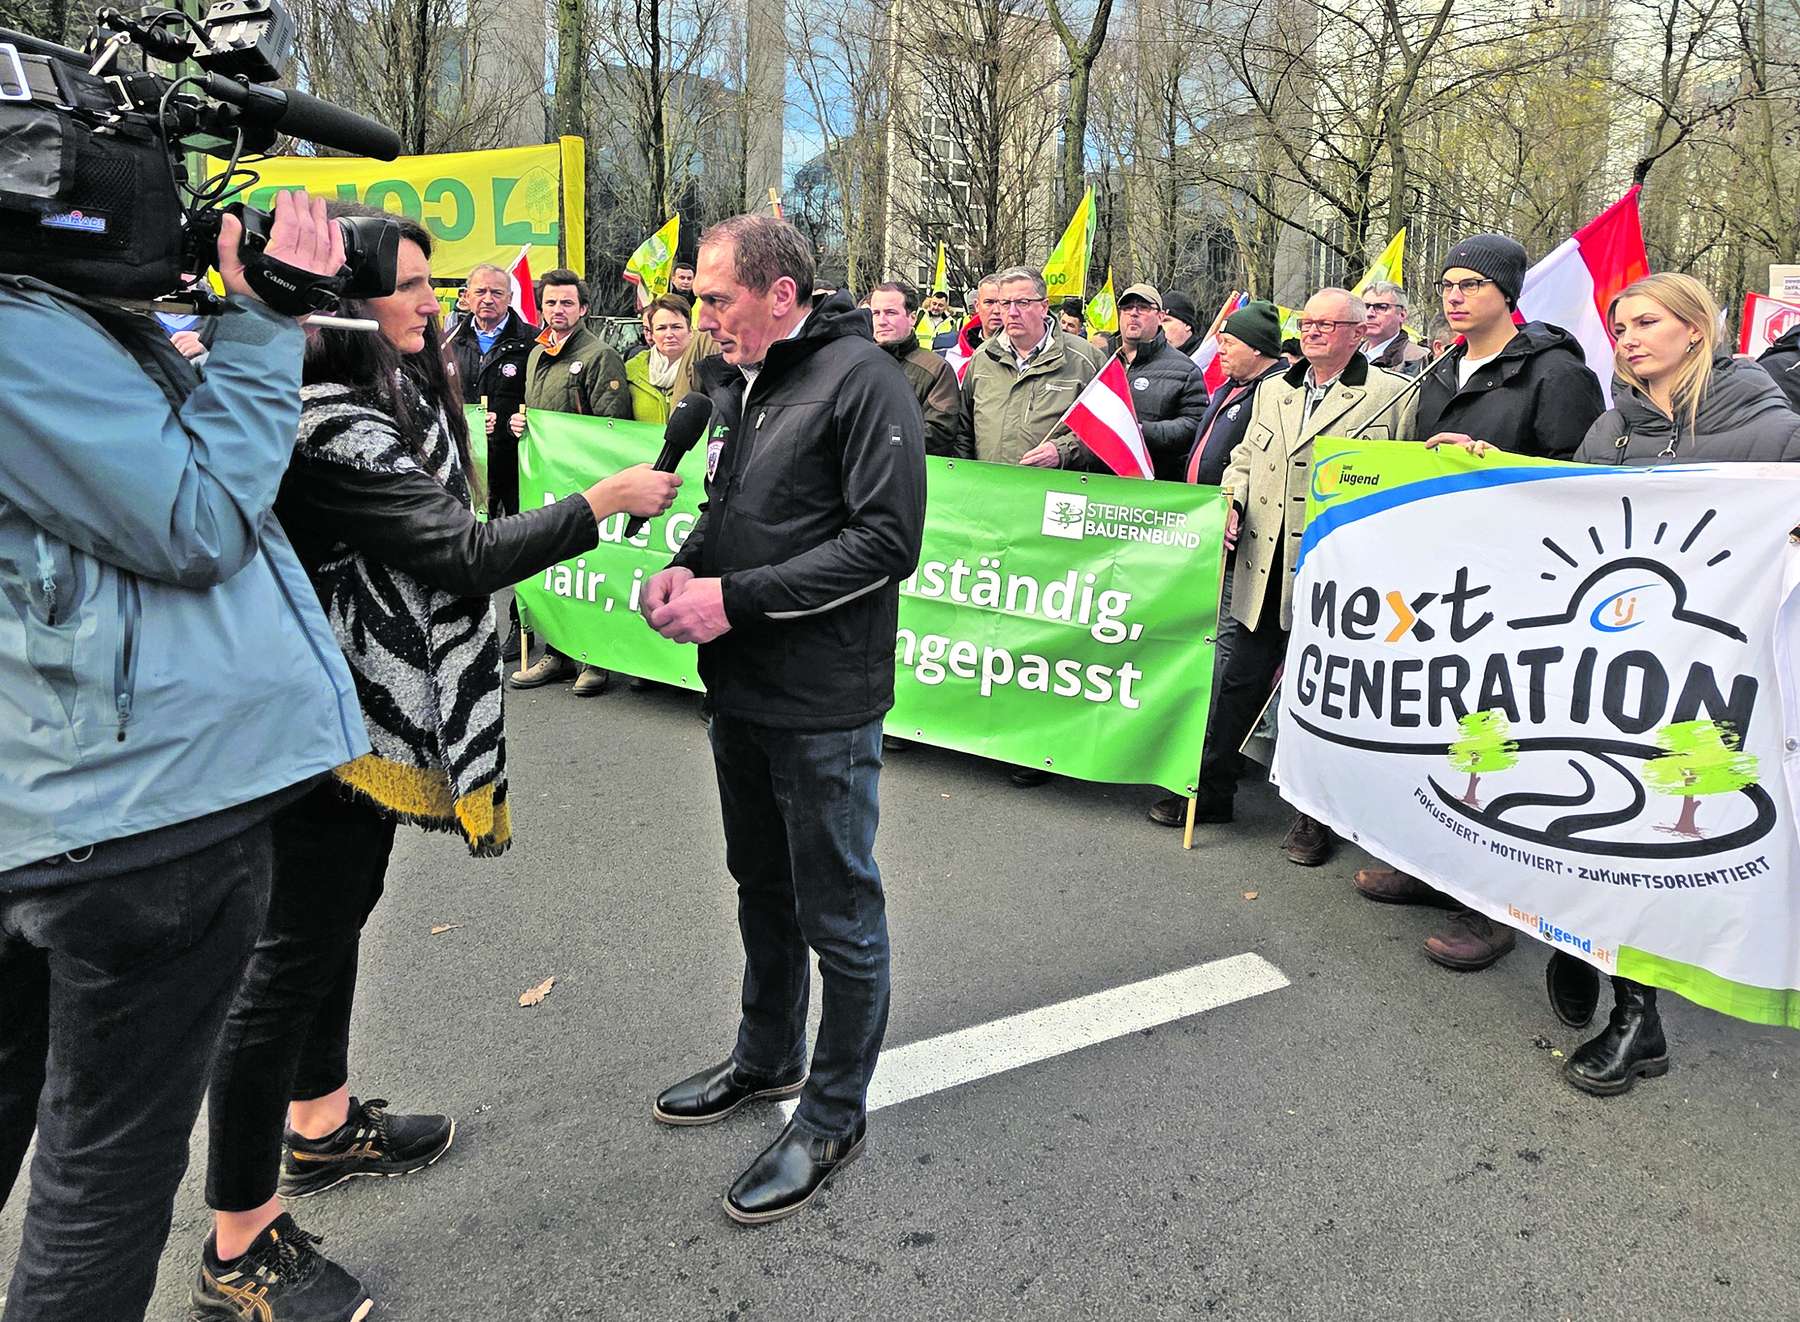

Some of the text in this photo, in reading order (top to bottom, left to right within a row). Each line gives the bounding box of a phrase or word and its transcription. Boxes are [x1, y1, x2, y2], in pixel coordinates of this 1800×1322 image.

[263, 270, 297, 292] Canon
[1339, 470, 1380, 486] jugend
[1087, 503, 1188, 528] STEIRISCHER
[1085, 521, 1201, 549] BAUERNBUND
[1311, 567, 1494, 643] next
[1297, 643, 1759, 753] GENERATION
[1490, 840, 1563, 875] MOTIVIERT
